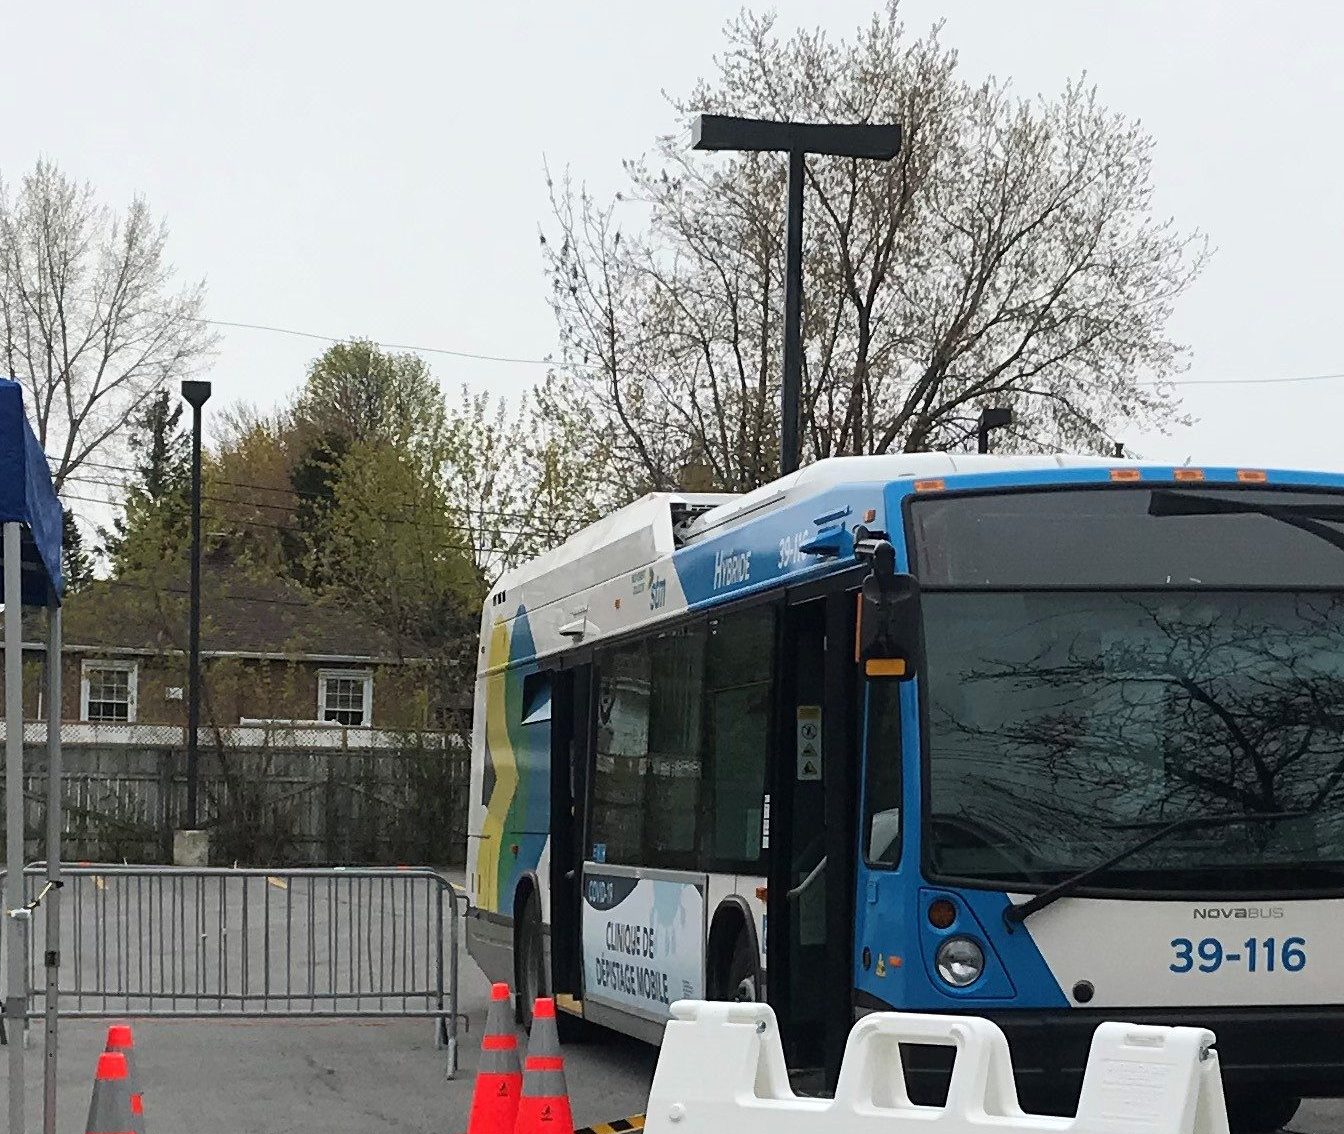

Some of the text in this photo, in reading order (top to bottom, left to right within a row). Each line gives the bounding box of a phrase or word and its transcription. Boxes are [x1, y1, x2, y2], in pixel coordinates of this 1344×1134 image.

[606, 921, 654, 959] CLINIQUE DE
[1169, 936, 1306, 973] 39-116
[595, 951, 636, 996] DÉPISTAGE
[636, 966, 669, 1004] MOBILE
